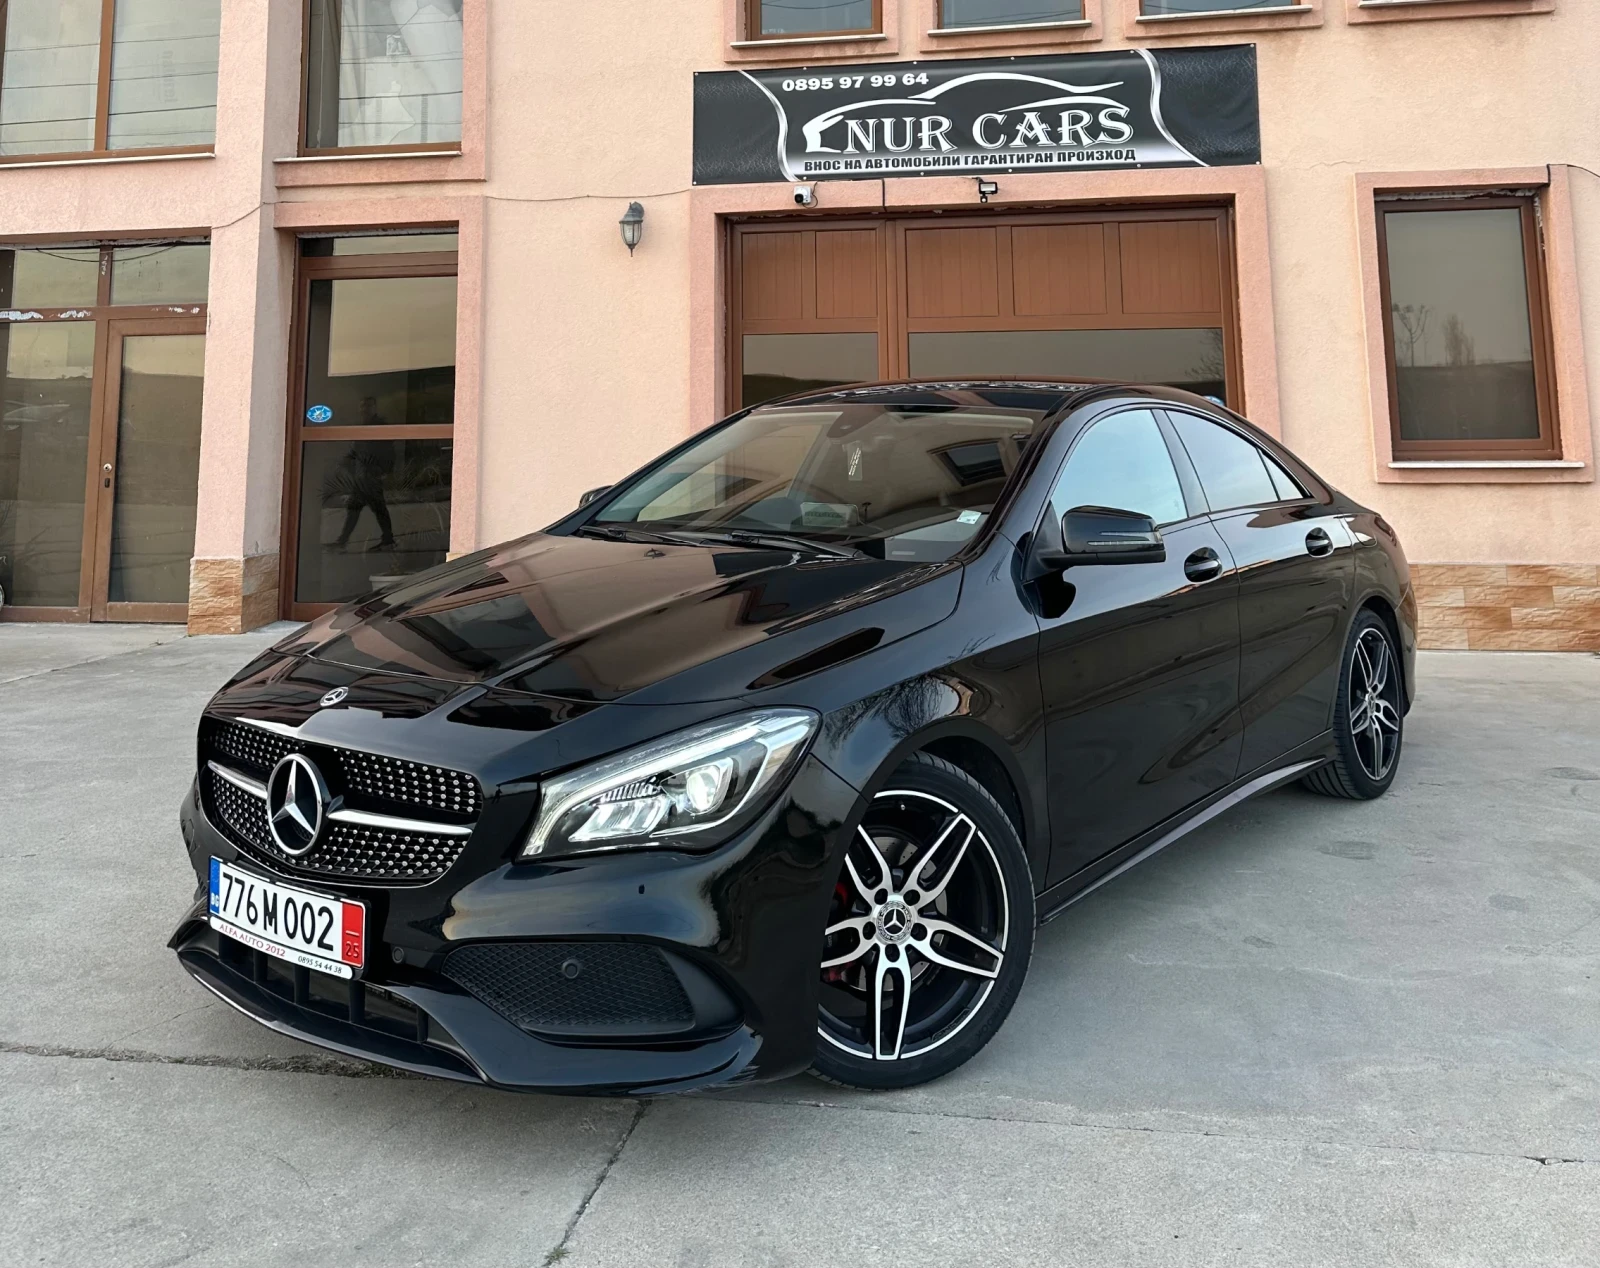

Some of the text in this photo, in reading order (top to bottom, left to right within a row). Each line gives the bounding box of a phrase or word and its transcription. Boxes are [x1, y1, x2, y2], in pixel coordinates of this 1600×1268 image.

[782, 72, 929, 92] 0895 97 99 64
[843, 108, 1134, 154] NUR CARS
[804, 148, 1136, 172] ВНОС НА АВТОМОБИЛИ ГАРАНТИРАН ПРОИЗХОД
[219, 923, 287, 958] ALFA AUTO 2012
[345, 940, 360, 959] 25
[297, 955, 313, 966] 0895
